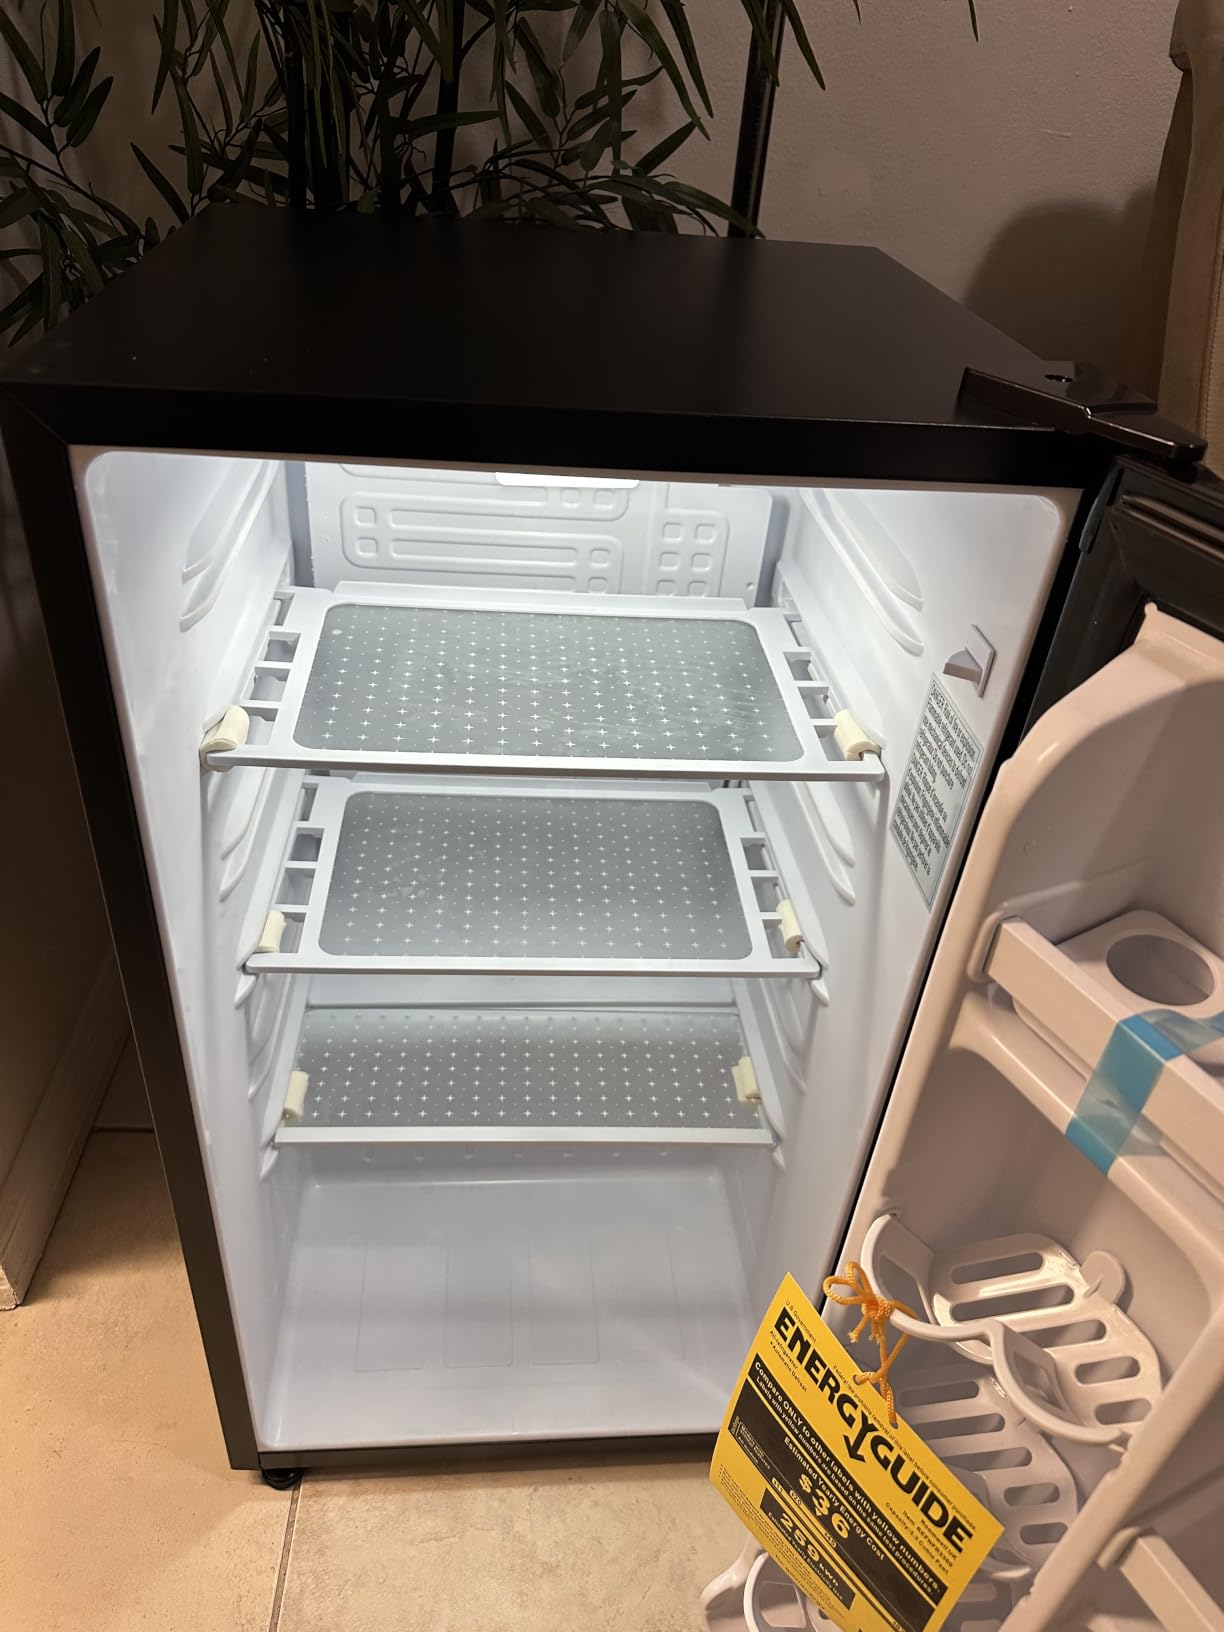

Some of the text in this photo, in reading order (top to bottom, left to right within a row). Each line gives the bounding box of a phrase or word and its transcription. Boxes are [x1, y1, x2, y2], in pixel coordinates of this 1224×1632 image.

[792, 1309, 817, 1343] Government
[771, 1344, 807, 1392] Automatic Defrost
[755, 1376, 772, 1400] Labels
[771, 1397, 783, 1413] with
[781, 1411, 799, 1435] yellow
[798, 1431, 822, 1463] numbers
[821, 1461, 831, 1475] are
[830, 1472, 848, 1496] based
[847, 1494, 857, 1506] on
[855, 1503, 867, 1518] the
[865, 1516, 883, 1537] same
[882, 1535, 896, 1552] test
[832, 1364, 849, 1386] Federal
[846, 1383, 855, 1394] law
[853, 1391, 872, 1416] prohibits
[871, 1412, 890, 1435] removal
[888, 1432, 895, 1441] of
[893, 1437, 903, 1450] this
[902, 1447, 915, 1463] label
[913, 1460, 929, 1480] before
[928, 1478, 952, 1506] consumer
[754, 1360, 941, 1593] Compare ONLY to other labels with yellow numbers.
[783, 1436, 885, 1561] Estimated Yearly Energy Cost
[797, 1471, 852, 1541] $36
[767, 1511, 791, 1541] Estimated
[791, 1539, 806, 1559] Yearly
[806, 1557, 832, 1589] Electricity
[831, 1587, 842, 1600] Use
[779, 1512, 820, 1563] 259
[818, 1561, 838, 1587] kWh
[918, 1539, 935, 1560] Cubic
[934, 1557, 949, 1575] Feet
[946, 1548, 957, 1561] UK
